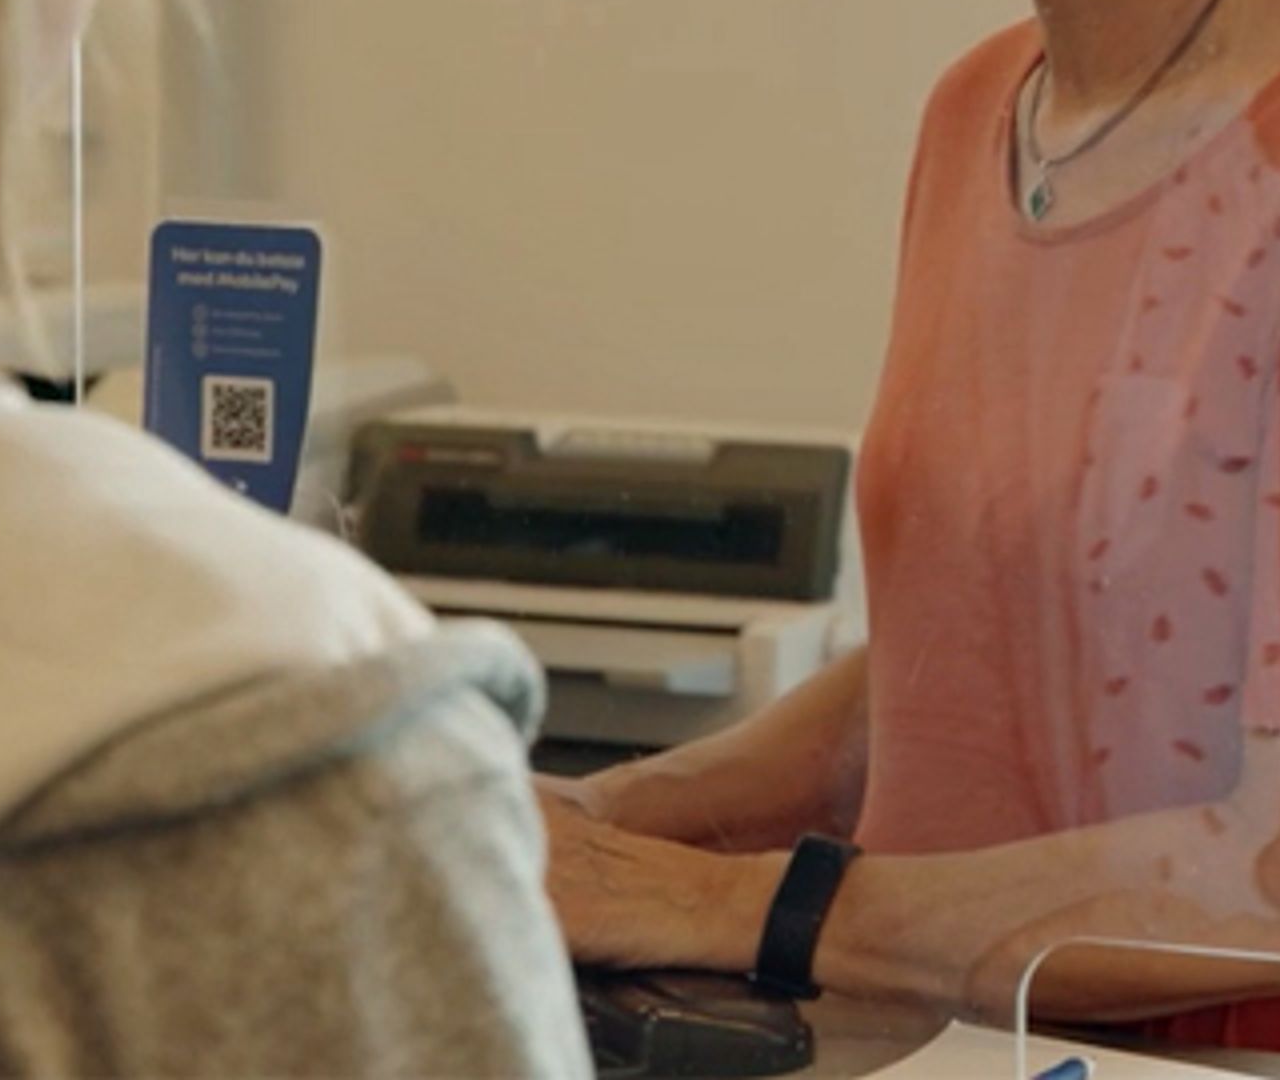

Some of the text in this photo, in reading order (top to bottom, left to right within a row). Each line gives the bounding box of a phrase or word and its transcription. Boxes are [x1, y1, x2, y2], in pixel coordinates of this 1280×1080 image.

[171, 245, 200, 262] Her
[203, 248, 233, 265] kan
[235, 250, 254, 266] du
[176, 271, 299, 296] med MobilePay
